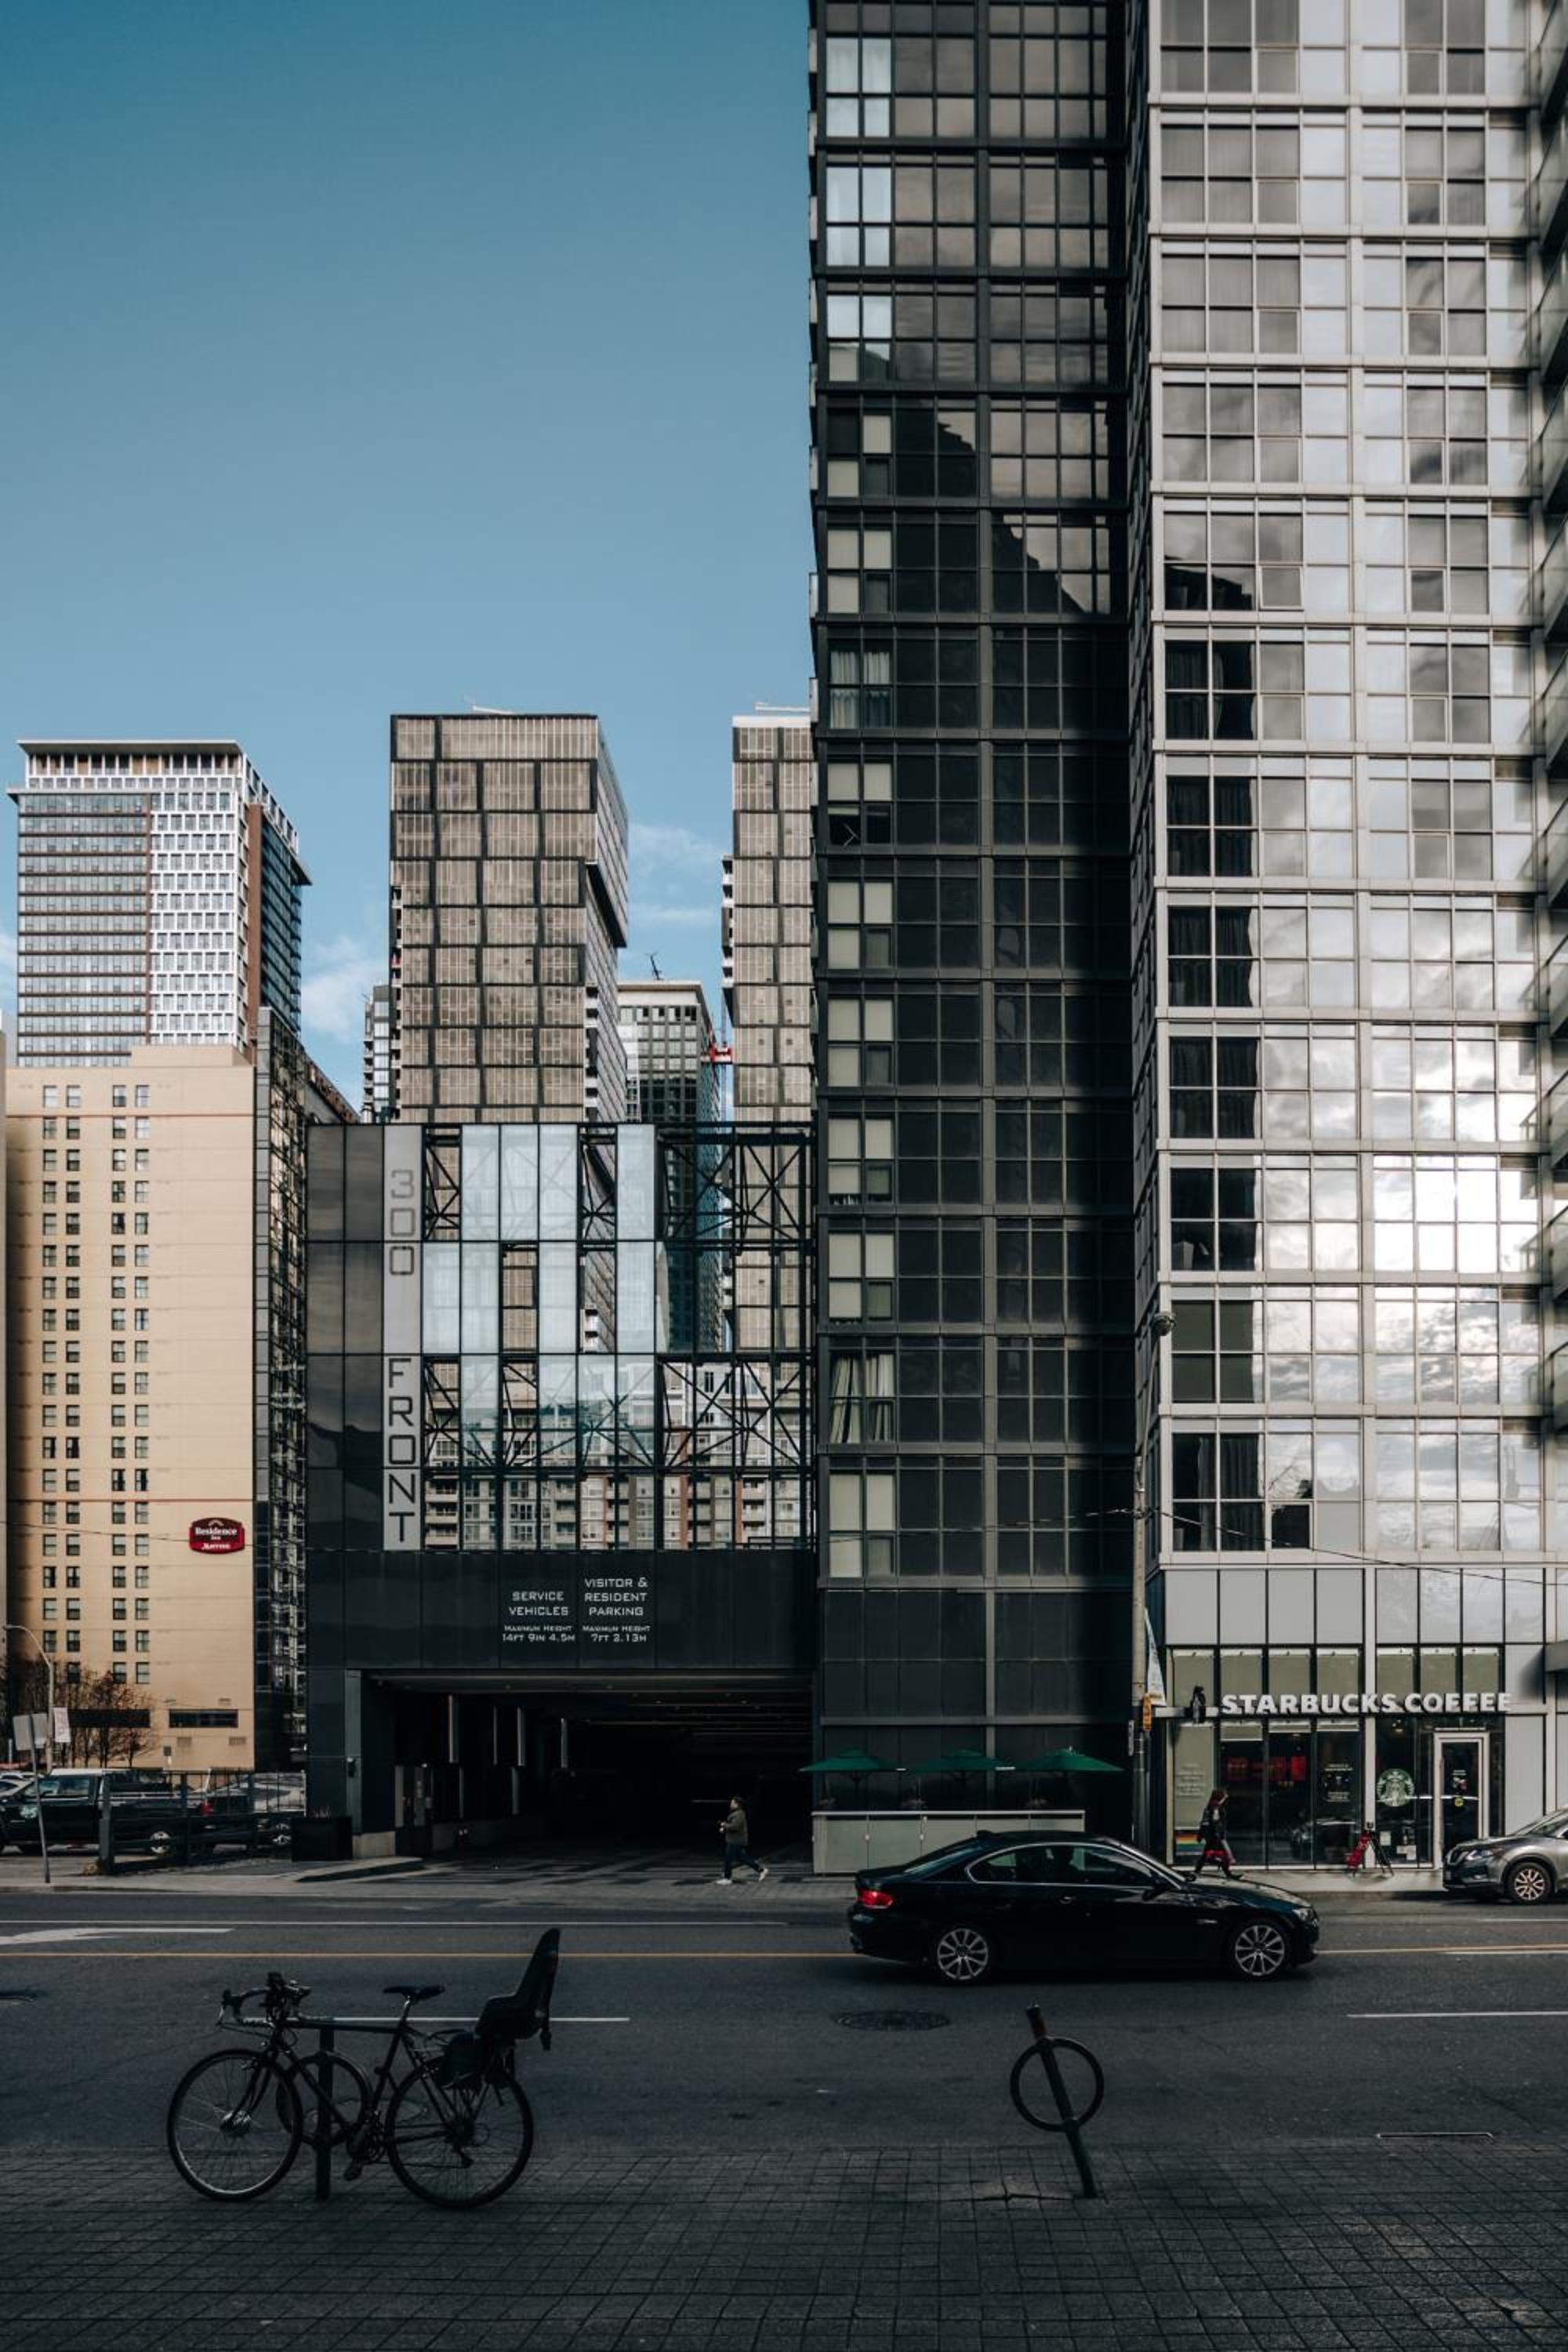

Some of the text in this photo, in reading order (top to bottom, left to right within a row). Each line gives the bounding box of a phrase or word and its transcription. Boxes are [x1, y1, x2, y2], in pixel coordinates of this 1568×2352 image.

[388, 1169, 416, 1542] 300 FRONT
[584, 1577, 648, 1588] VISITOR &
[512, 1591, 564, 1602] SERVICE
[584, 1592, 648, 1602] RESIDENT
[509, 1606, 568, 1616] VEHICLES
[589, 1606, 644, 1616] PARKING
[1221, 1692, 1513, 1715] STARBUCKS COFFEE
